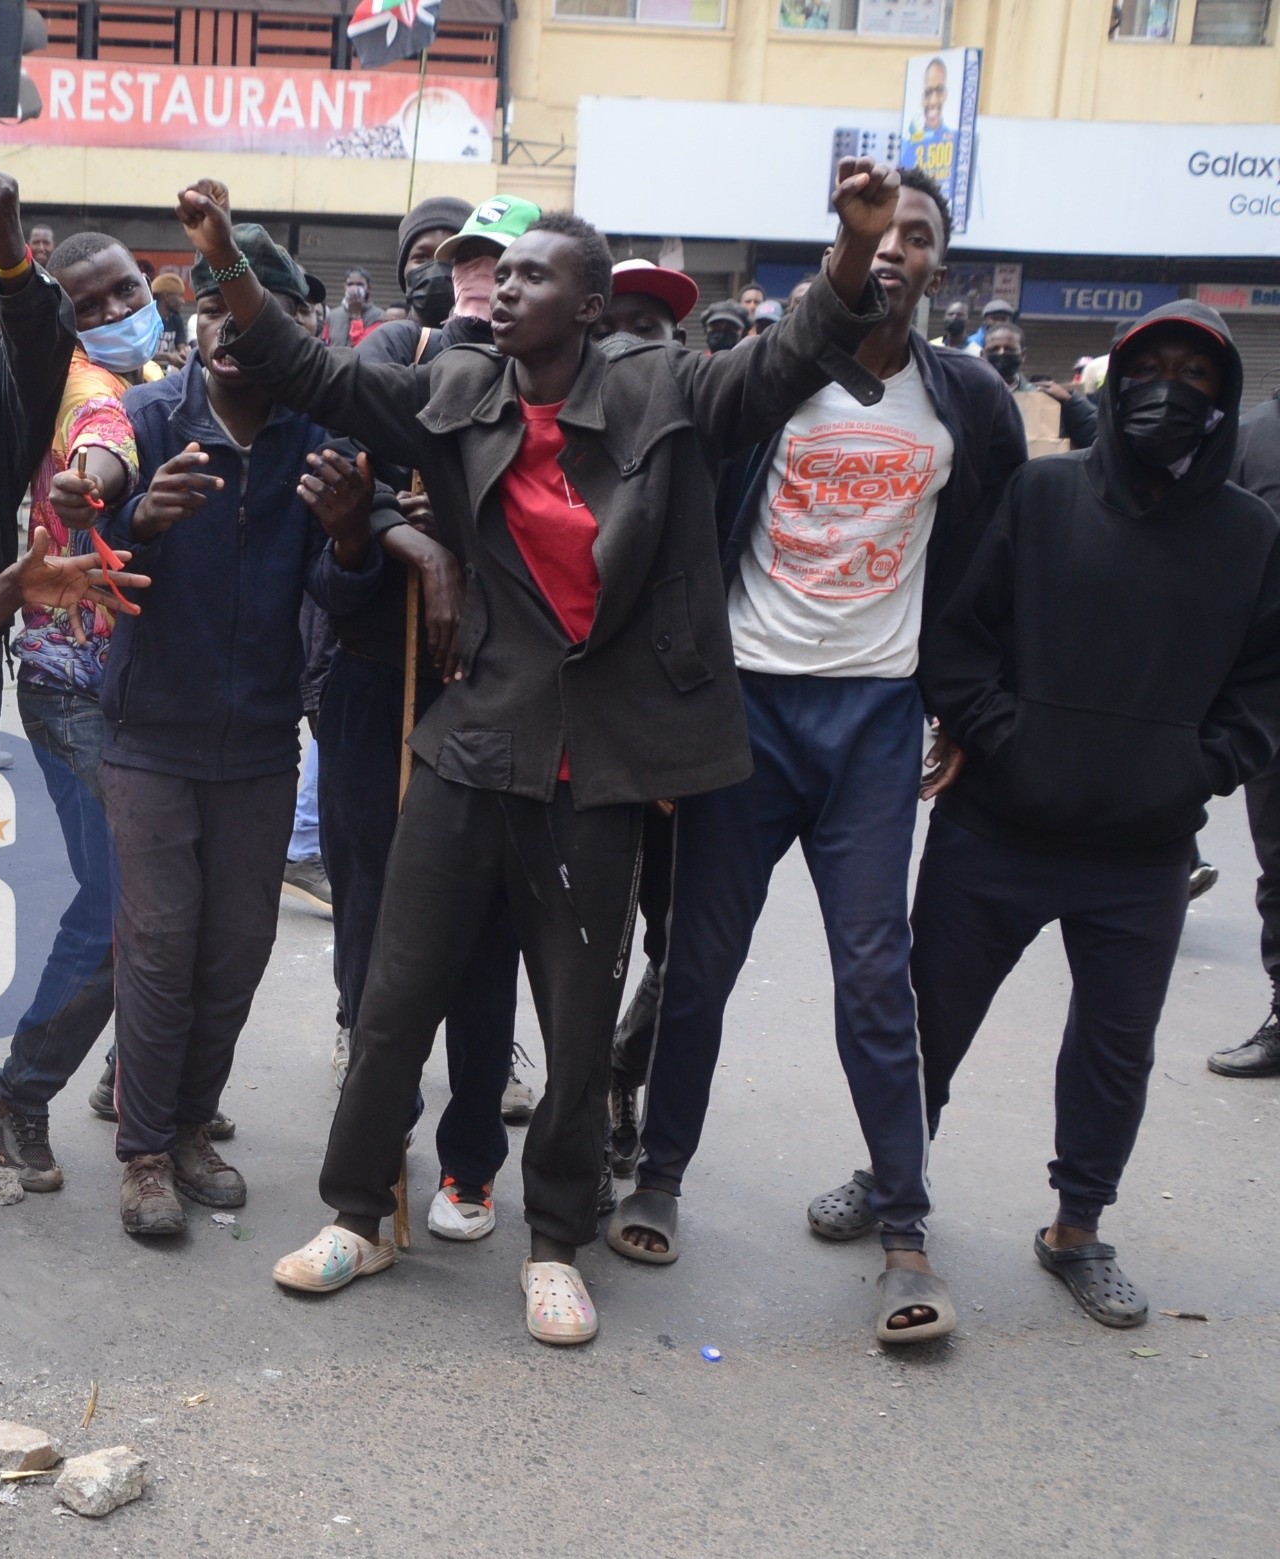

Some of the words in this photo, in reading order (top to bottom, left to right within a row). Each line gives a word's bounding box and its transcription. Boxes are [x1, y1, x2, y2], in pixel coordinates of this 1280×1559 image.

[49, 68, 372, 129] RESTAURANT
[1188, 151, 1280, 187] Galax
[1061, 288, 1143, 311] TECNO
[797, 451, 911, 480] CAR
[772, 471, 934, 511] SHOW
